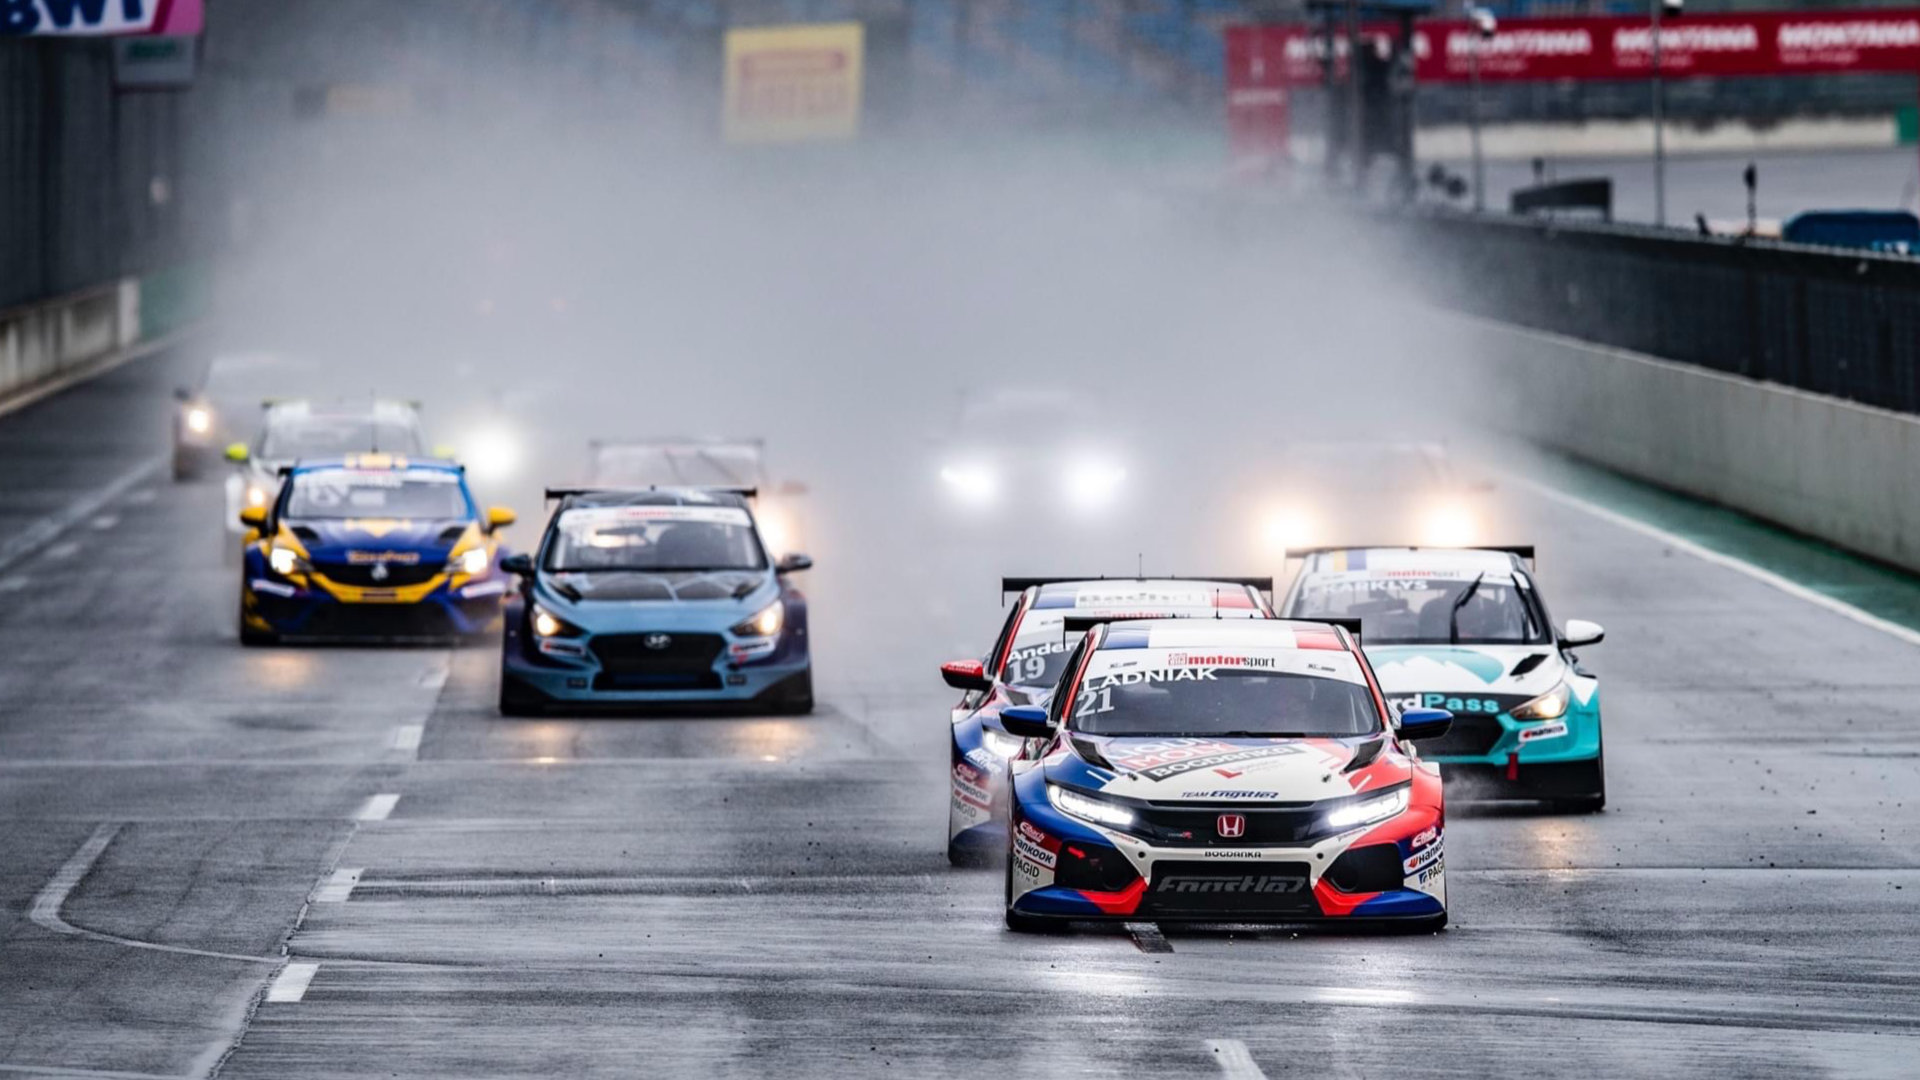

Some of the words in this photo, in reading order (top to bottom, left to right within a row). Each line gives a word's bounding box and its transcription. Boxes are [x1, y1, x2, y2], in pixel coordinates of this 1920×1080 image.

[1006, 640, 1082, 664] Ander
[1188, 655, 1275, 668] motorsport
[1009, 656, 1046, 685] 19
[1083, 667, 1217, 692] LADNIAK
[1075, 687, 1115, 718] 21
[1388, 694, 1499, 713] rdPass
[1181, 791, 1209, 799] TEAM
[1017, 838, 1054, 864] ankook
[1205, 850, 1262, 859] BOGDANKA
